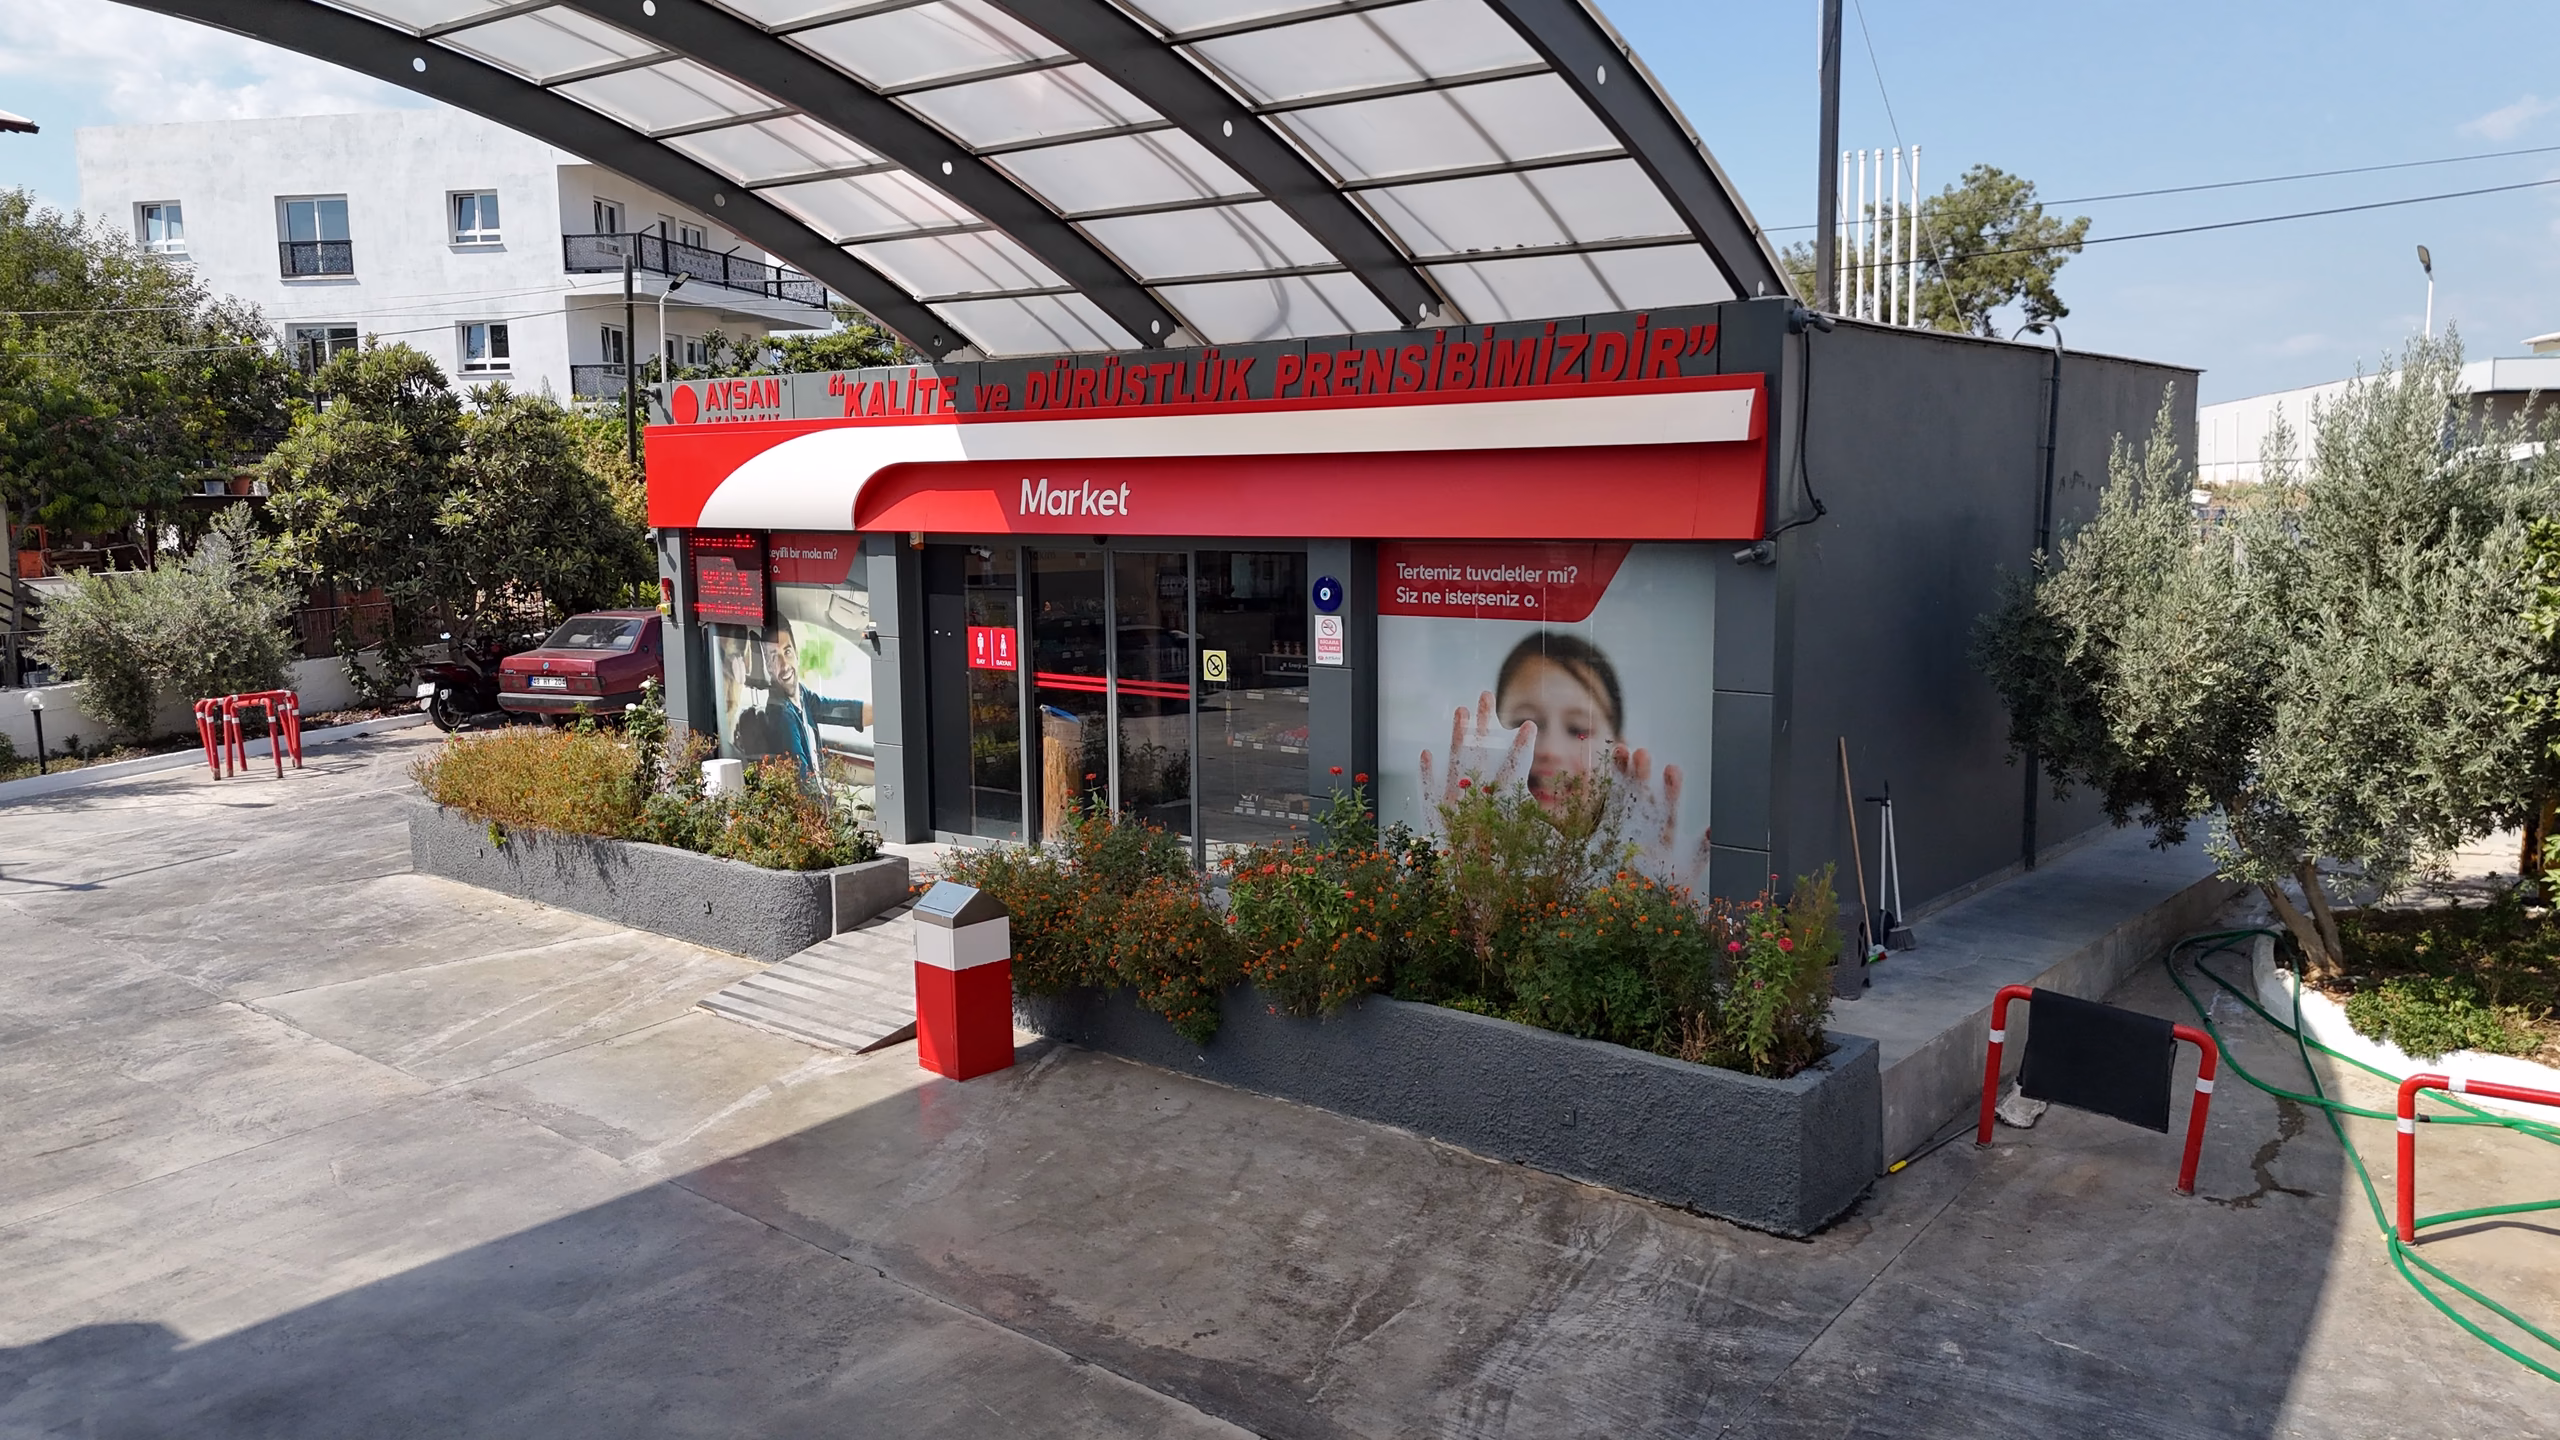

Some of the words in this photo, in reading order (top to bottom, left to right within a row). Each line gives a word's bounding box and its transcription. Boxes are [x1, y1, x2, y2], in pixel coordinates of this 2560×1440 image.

[973, 383, 1010, 412] ve
[1024, 348, 1256, 409] DÜRÜSTLÜK
[705, 378, 780, 411] AYSAN
[1020, 478, 1131, 516] Market
[789, 547, 800, 558] bir
[802, 548, 821, 559] mola
[1396, 562, 1462, 581] Tertemiz
[1466, 564, 1543, 583] tuvaletler
[1547, 566, 1578, 584] mi?
[1396, 586, 1418, 604] Siz
[1422, 591, 1442, 604] ne
[1445, 588, 1519, 607] isterseniz
[1523, 595, 1539, 608] o.
